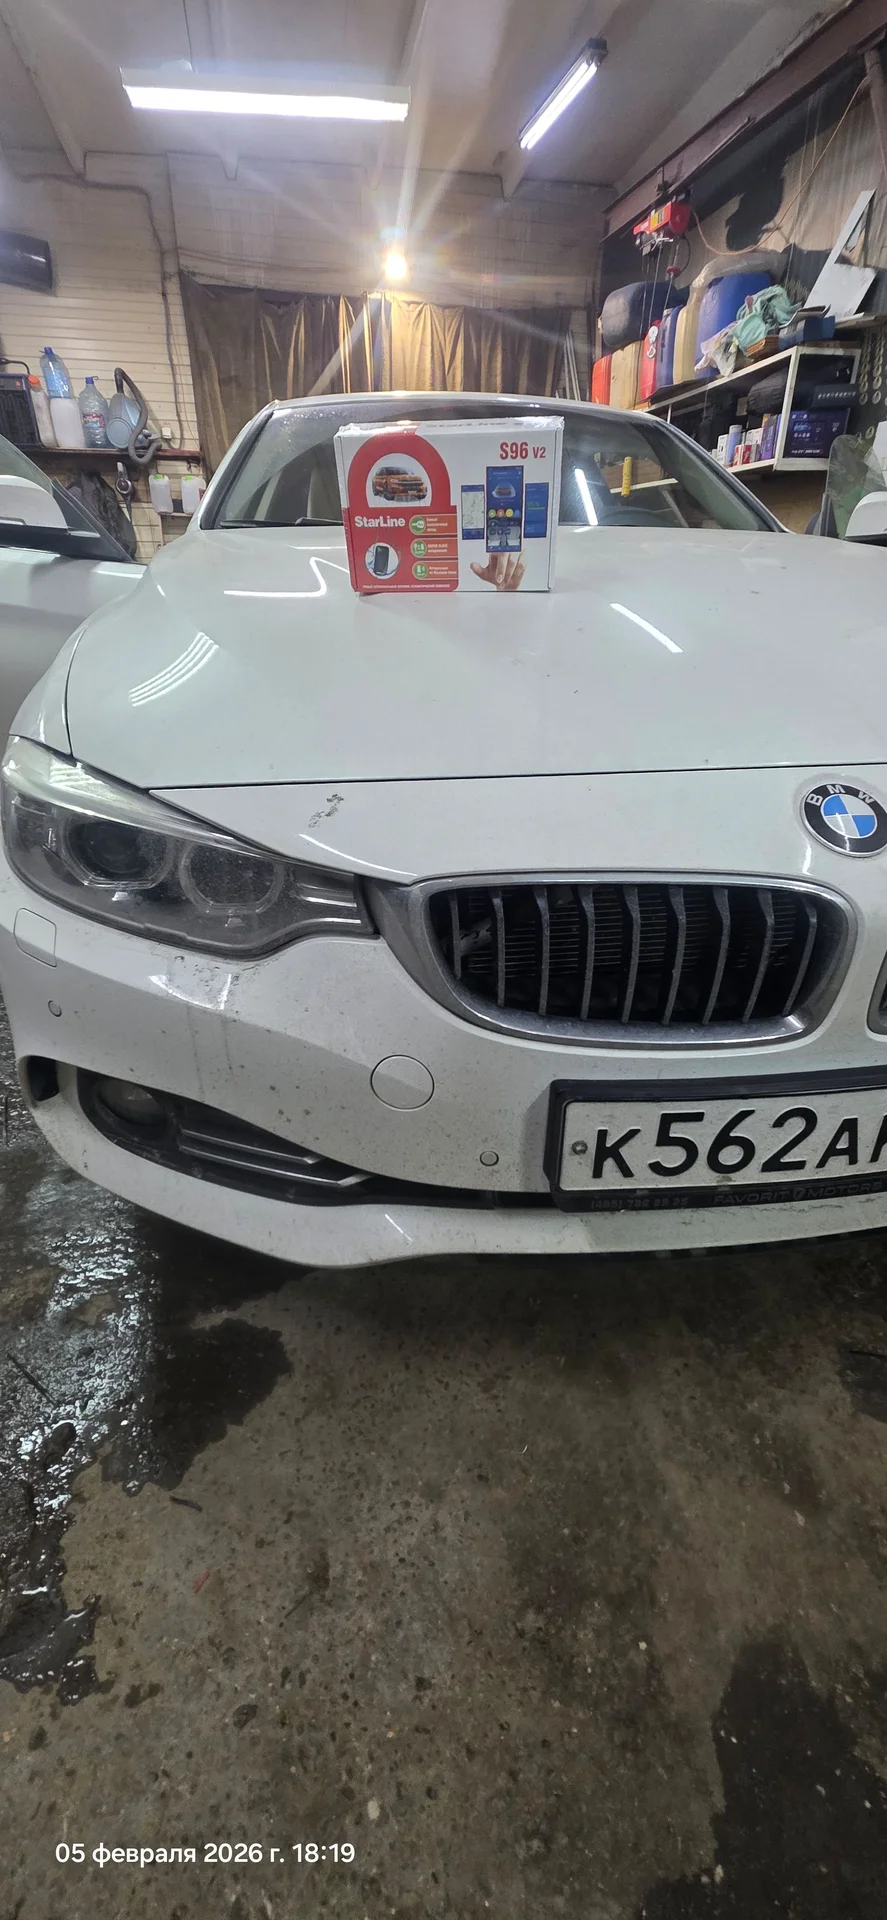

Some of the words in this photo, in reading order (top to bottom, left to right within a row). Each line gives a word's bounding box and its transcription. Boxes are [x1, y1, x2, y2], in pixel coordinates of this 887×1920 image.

[499, 441, 528, 460] S96
[354, 515, 405, 527] StarLine
[806, 785, 875, 806] BMW
[713, 1190, 790, 1204] FAVORIT
[808, 1181, 883, 1197] MOTORS
